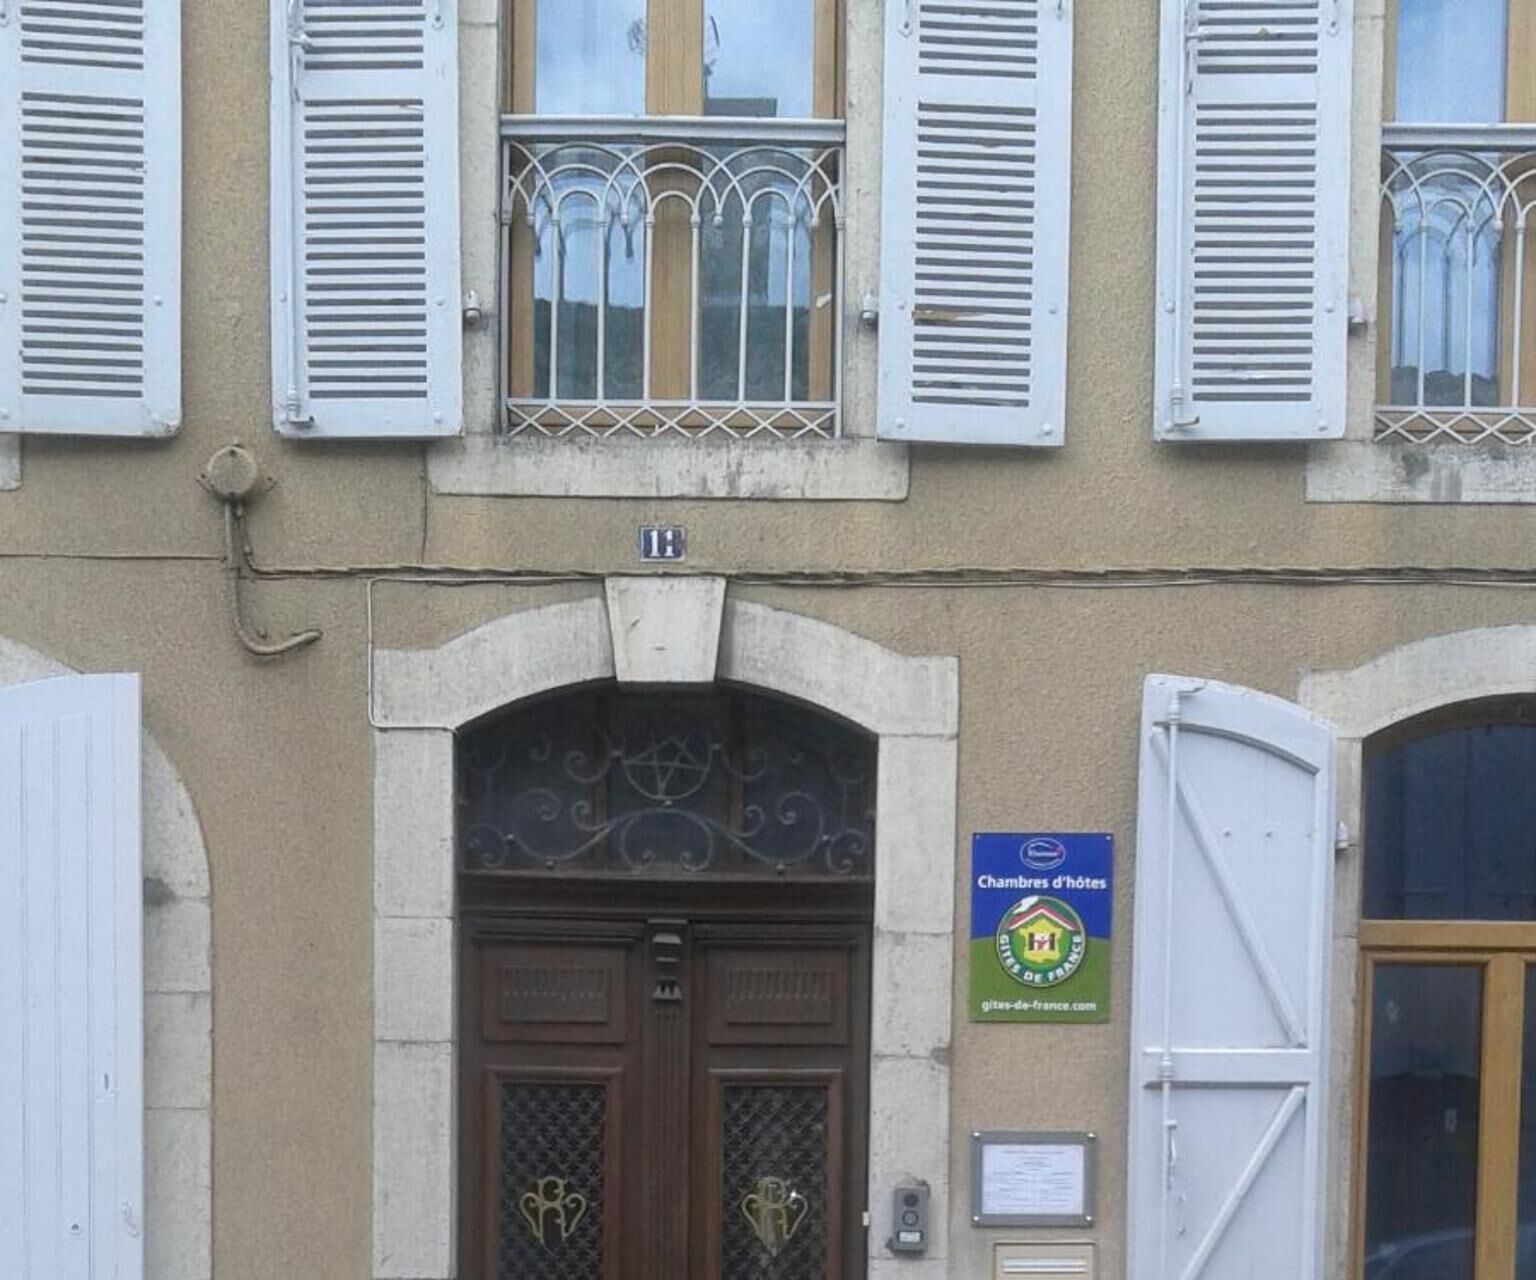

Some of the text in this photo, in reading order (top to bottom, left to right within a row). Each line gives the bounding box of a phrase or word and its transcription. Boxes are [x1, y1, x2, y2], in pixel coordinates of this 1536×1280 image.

[978, 874, 1107, 890] Chambres d'hôtes
[1023, 971, 1043, 984] DE
[1047, 934, 1082, 982] FRANCE
